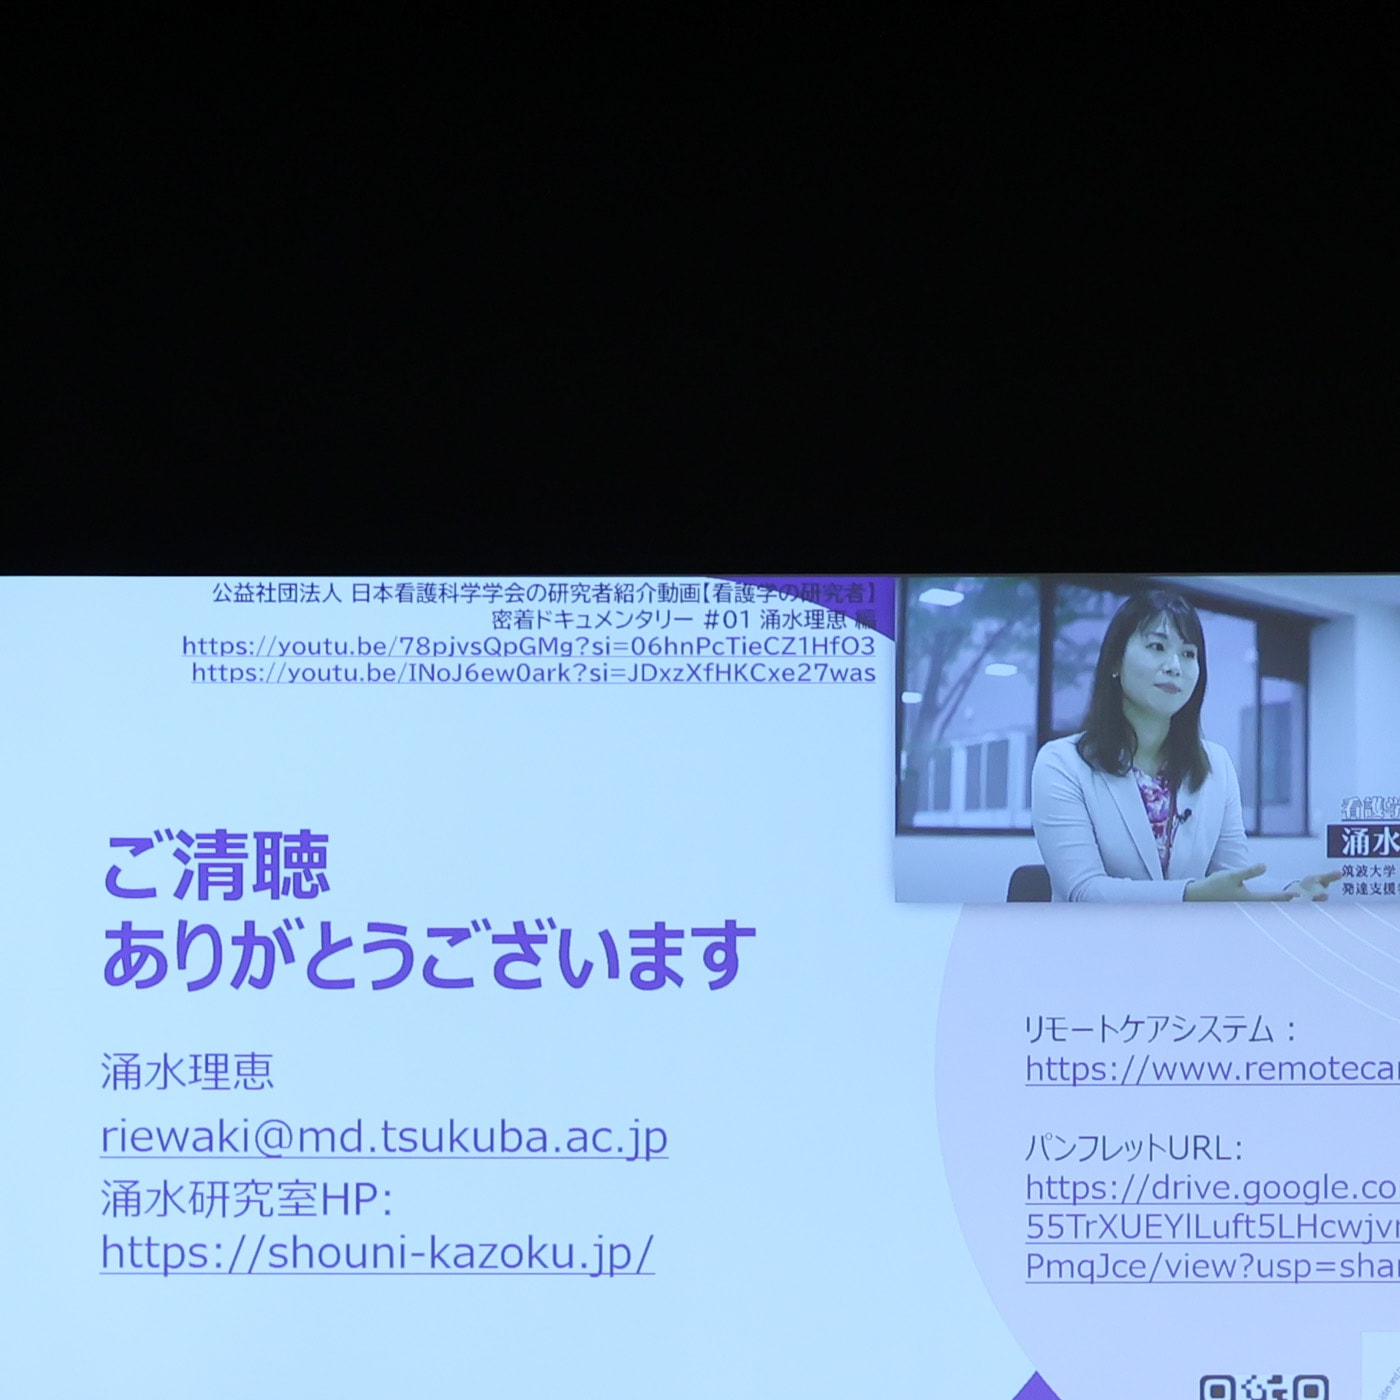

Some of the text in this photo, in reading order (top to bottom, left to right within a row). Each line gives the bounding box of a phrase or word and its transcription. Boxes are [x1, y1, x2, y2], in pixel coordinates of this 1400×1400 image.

[212, 582, 342, 604] 公益社団法人
[492, 609, 694, 631] 密着ドキュメンタリー
[760, 609, 847, 631] 涌水理恵
[104, 828, 331, 901] ご清聴
[104, 916, 757, 992] ありがとうございます
[100, 1051, 276, 1091] 涌水理恵
[100, 1118, 669, 1161] riewaki@md.tsukuba.ac.jp
[100, 1178, 393, 1219] 涌水研究室HP:
[100, 1233, 656, 1278] https://shouni-kazoku.jp/
